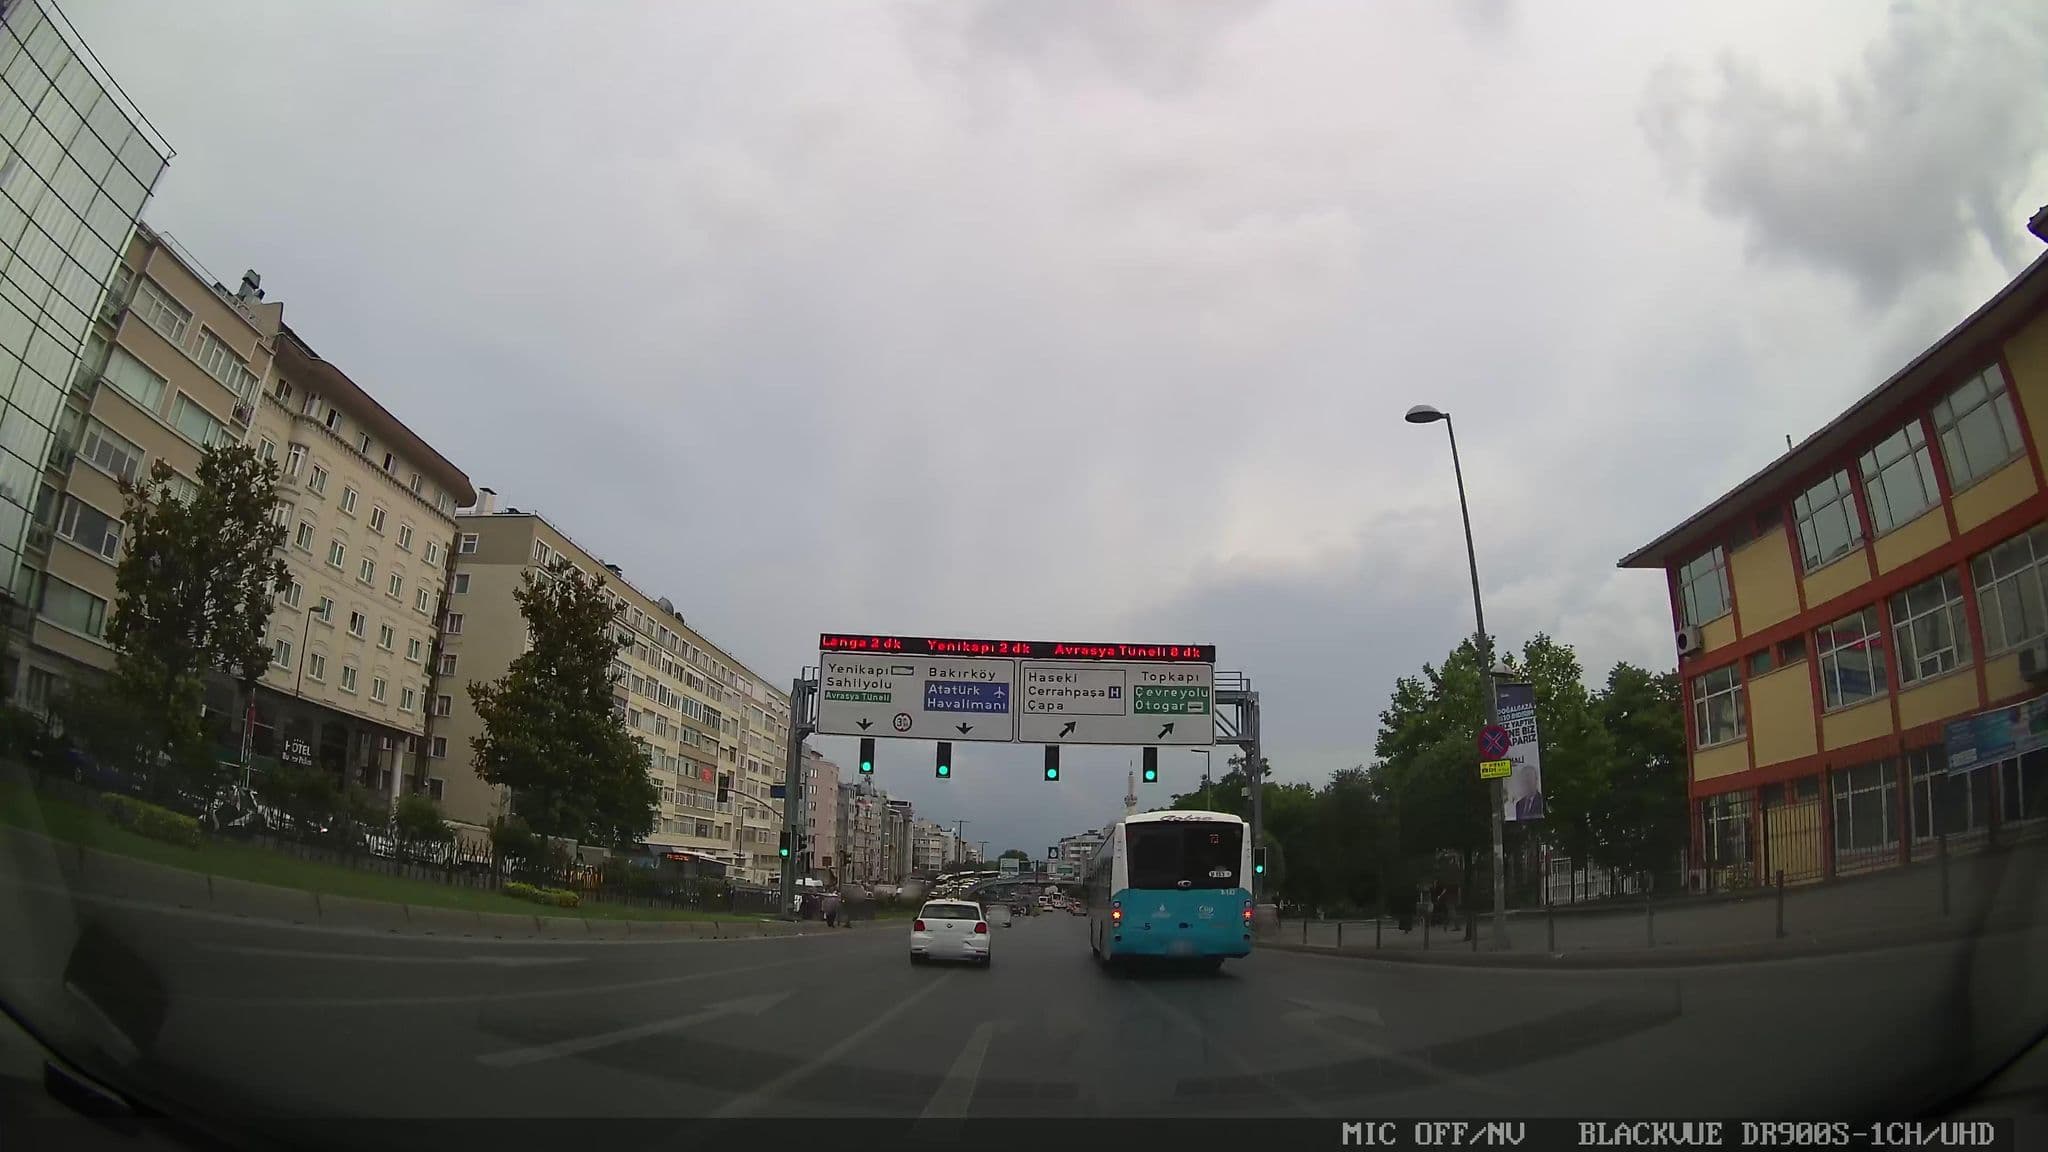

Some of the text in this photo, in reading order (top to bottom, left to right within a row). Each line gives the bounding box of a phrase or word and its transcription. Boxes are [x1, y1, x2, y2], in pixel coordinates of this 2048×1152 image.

[871, 638, 879, 648] 2
[884, 638, 901, 649] dk
[1000, 642, 1008, 653] 2
[1013, 643, 1030, 653] dk
[1055, 643, 1115, 657] Avrasya
[1183, 647, 1200, 658] dk
[828, 663, 888, 677] Yenikapı
[929, 667, 996, 681] Bakırköy
[827, 677, 892, 690] Sahilyolu
[1028, 672, 1077, 683] Haseki
[1142, 671, 1199, 684] Topkapı
[825, 691, 860, 701] Avrasya
[1028, 687, 1105, 699] Cerrahpaşa
[1135, 687, 1208, 699] Çevreyolu
[928, 698, 1006, 710] Havalimanı
[1028, 701, 1064, 712] Çapa
[1135, 701, 1184, 712] Otogar
[1511, 719, 1535, 728] YAPTIK
[285, 740, 311, 756] HOTEL
